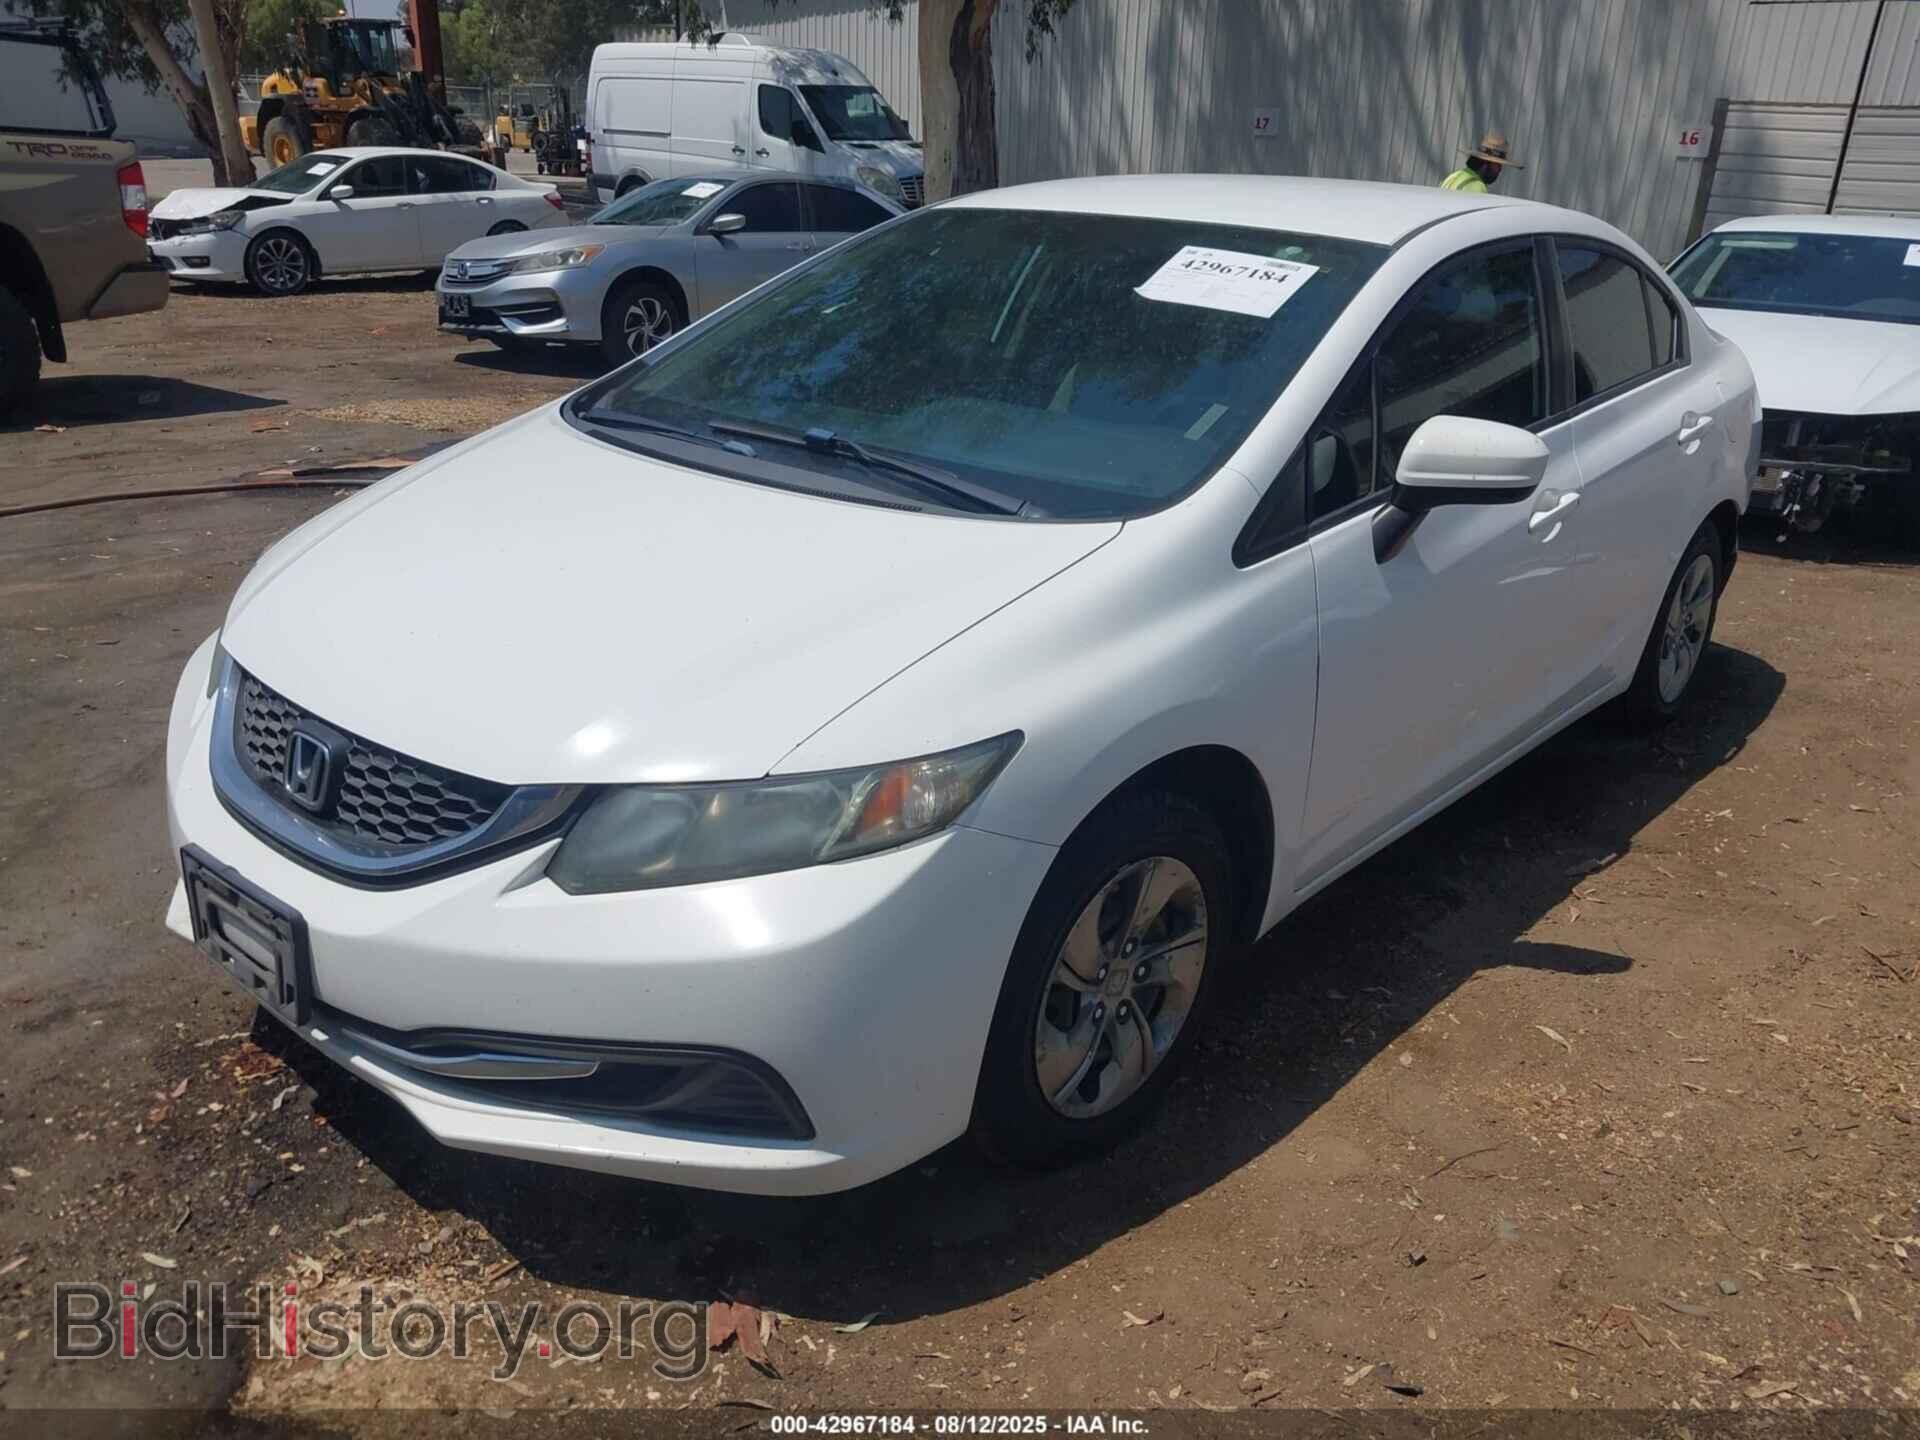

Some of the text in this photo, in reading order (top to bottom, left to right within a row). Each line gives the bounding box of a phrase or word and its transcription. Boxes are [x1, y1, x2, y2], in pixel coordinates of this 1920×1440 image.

[1255, 117, 1271, 129] 17
[1679, 131, 1700, 145] 16
[1181, 259, 1289, 284] 42967184
